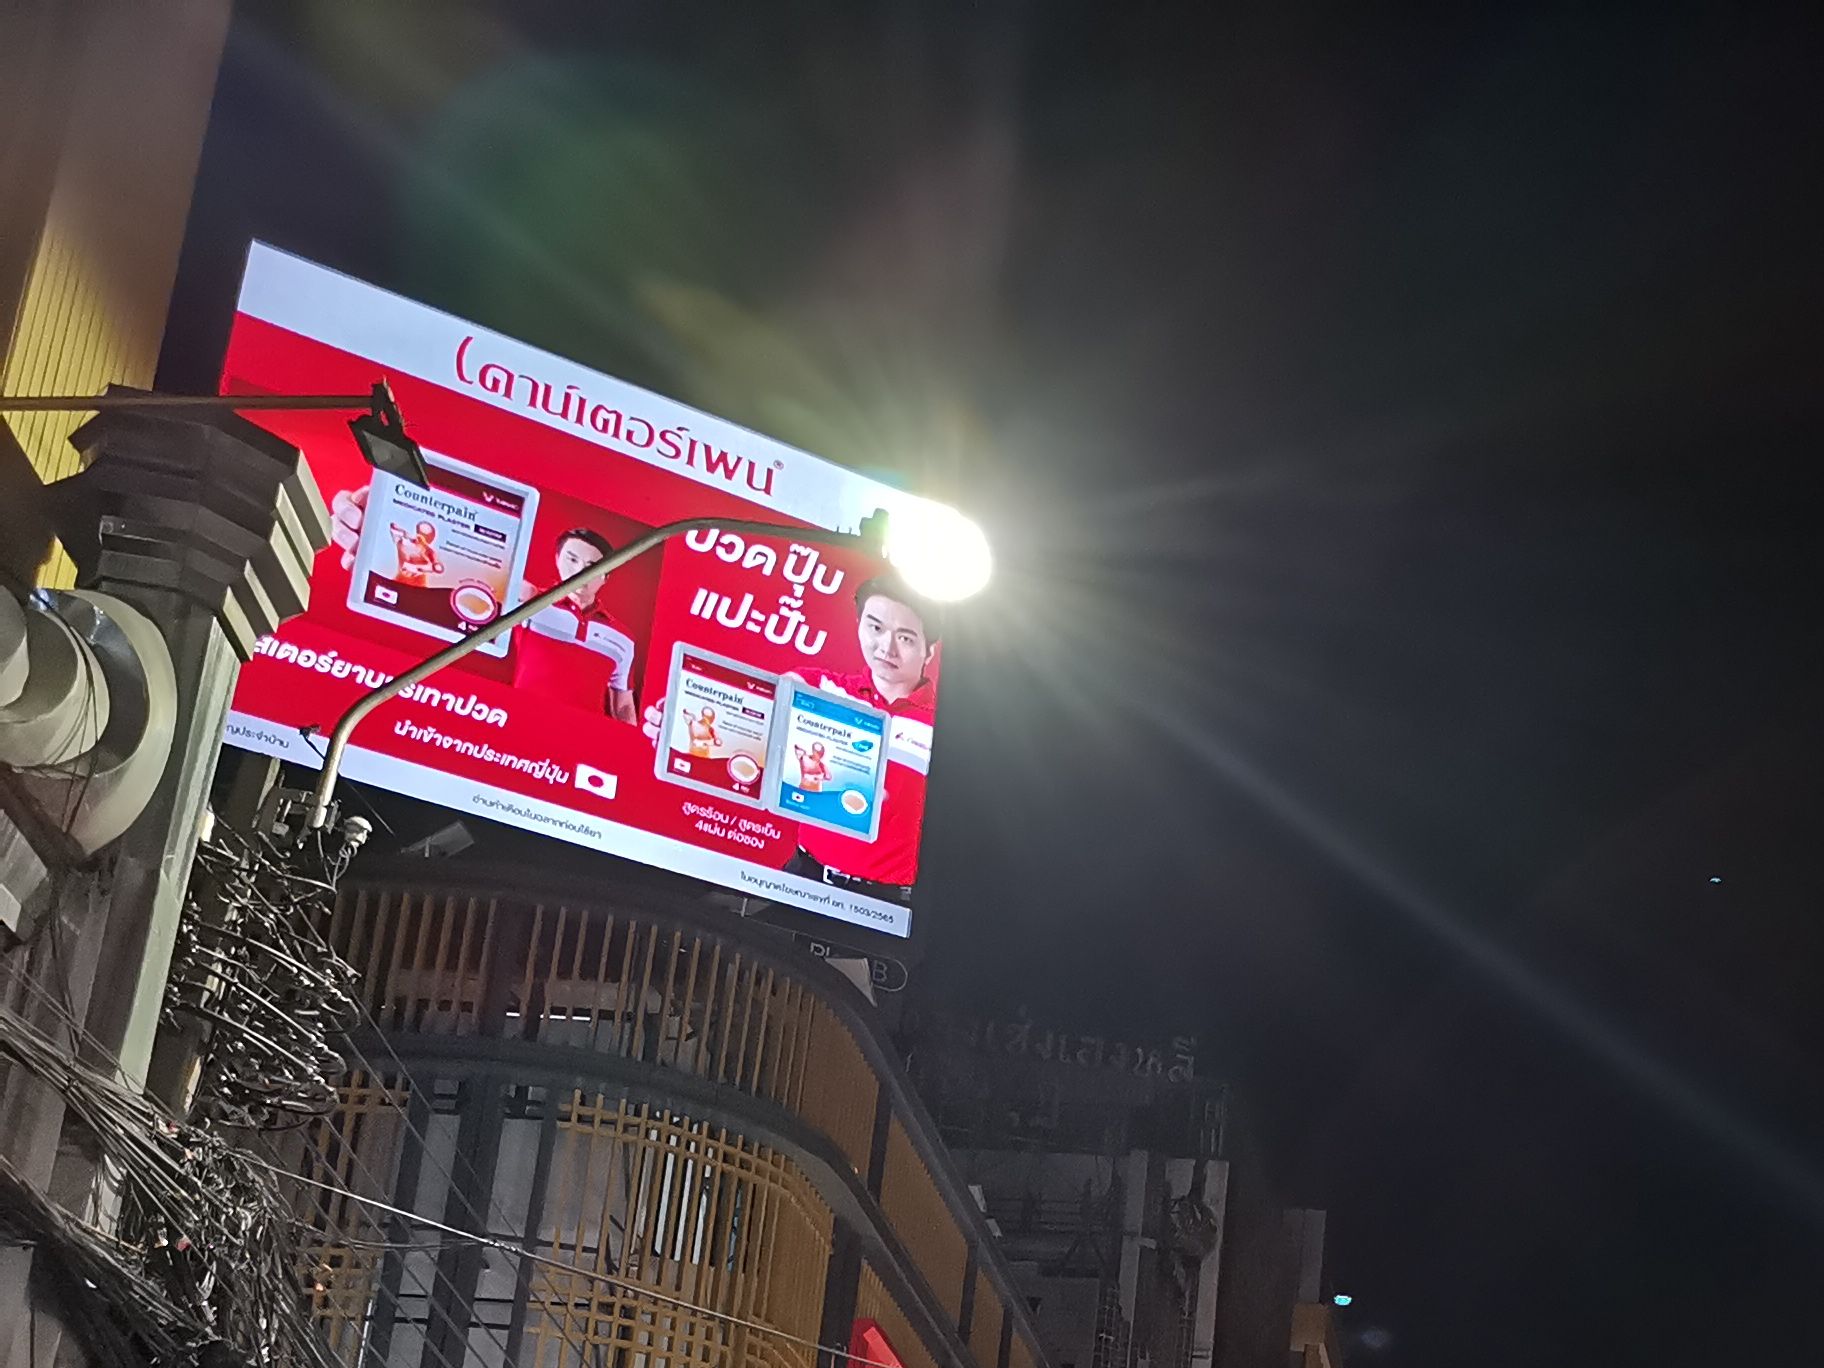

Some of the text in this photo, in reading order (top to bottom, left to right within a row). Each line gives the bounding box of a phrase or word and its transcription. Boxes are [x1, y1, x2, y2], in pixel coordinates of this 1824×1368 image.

[395, 483, 478, 522] Counterpain
[685, 677, 744, 705] Counterpain
[797, 714, 852, 738] Counterpain
